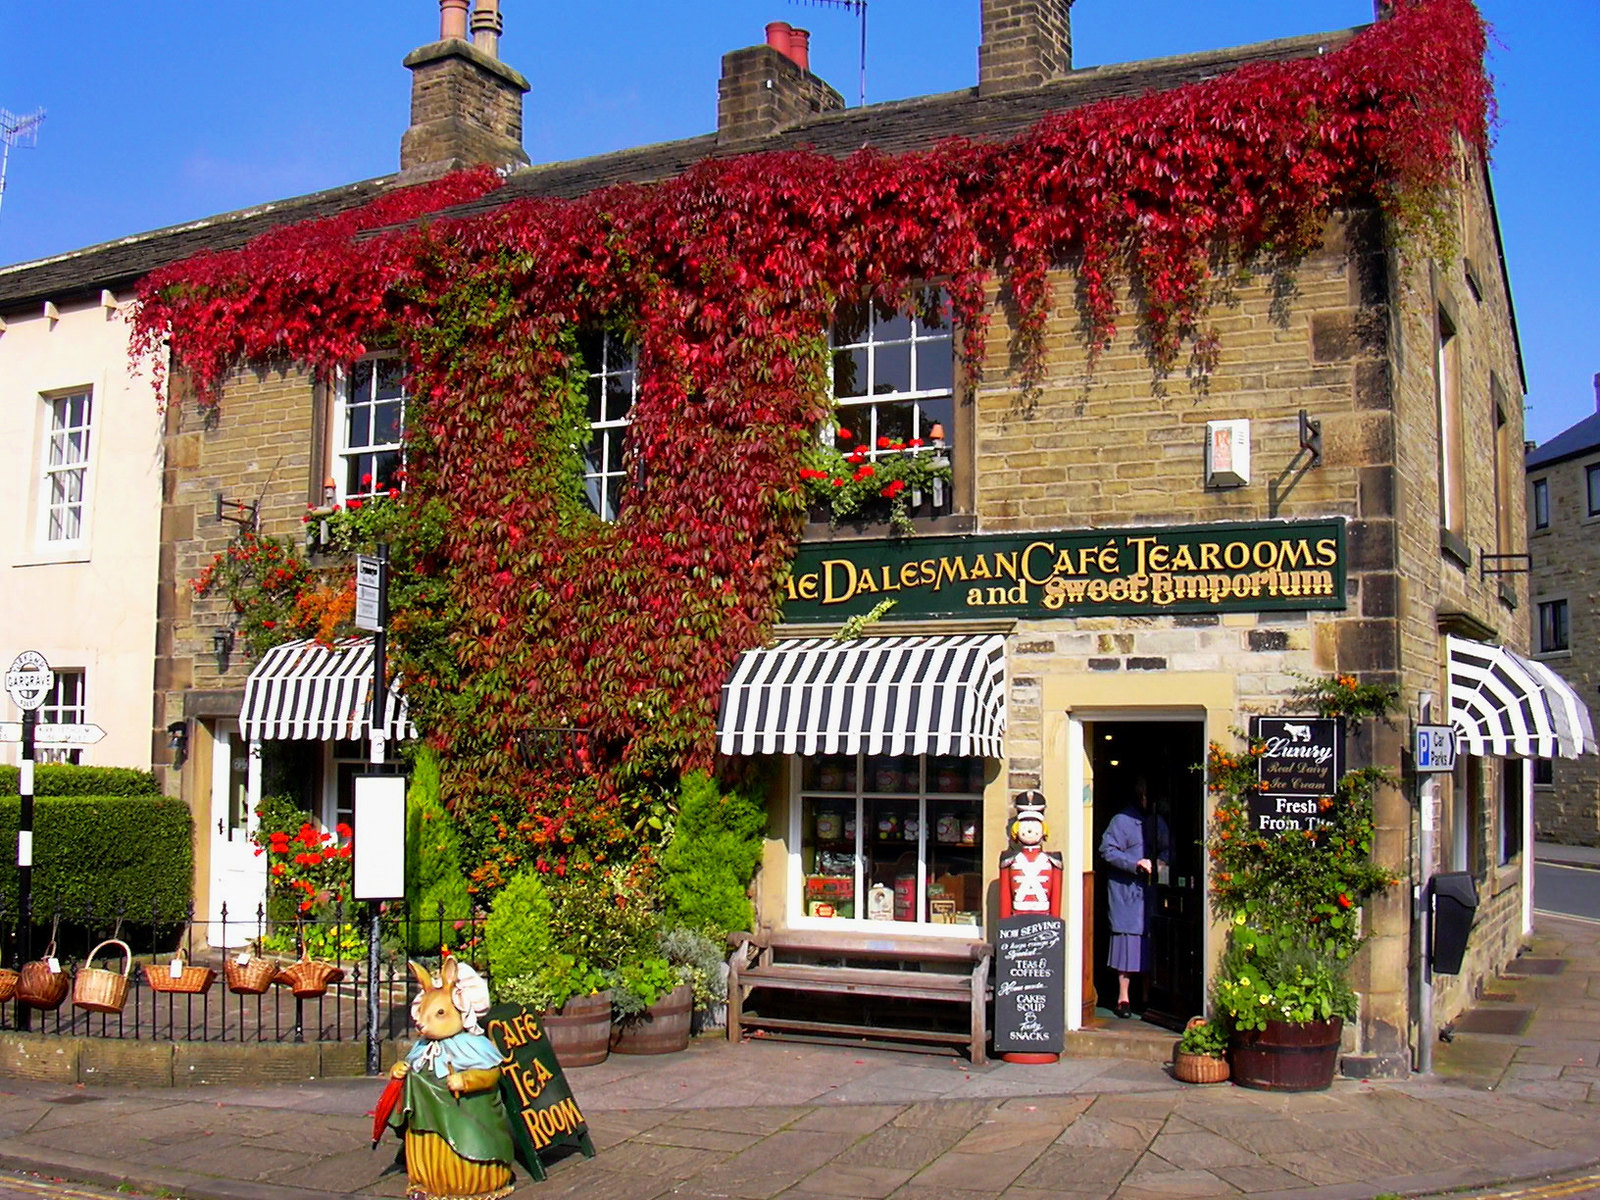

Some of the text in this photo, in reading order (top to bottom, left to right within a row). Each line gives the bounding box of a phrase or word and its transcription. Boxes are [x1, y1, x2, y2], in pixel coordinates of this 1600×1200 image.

[821, 551, 1017, 606] DALESMAN
[1020, 538, 1121, 586] CAFÉ
[1126, 536, 1338, 580] TEAROOMS
[966, 567, 1335, 610] and Sweet Emporium
[1433, 731, 1444, 747] Car
[1431, 750, 1447, 766] Parks
[1266, 763, 1295, 773] Real
[1270, 777, 1326, 790] Ice Cream
[1276, 798, 1317, 813] Fresh
[1260, 815, 1300, 830] From
[1000, 921, 1060, 939] NOW SERVING
[1016, 960, 1037, 969] TEAS
[1010, 968, 1051, 977] COFFEES
[1017, 994, 1046, 1003] CAKES
[1017, 1003, 1045, 1012] SOUP
[488, 1008, 542, 1063] CAFÉ
[1010, 1031, 1049, 1041] SNACKS
[502, 1058, 554, 1107] TEA
[521, 1097, 585, 1150] ROOM
